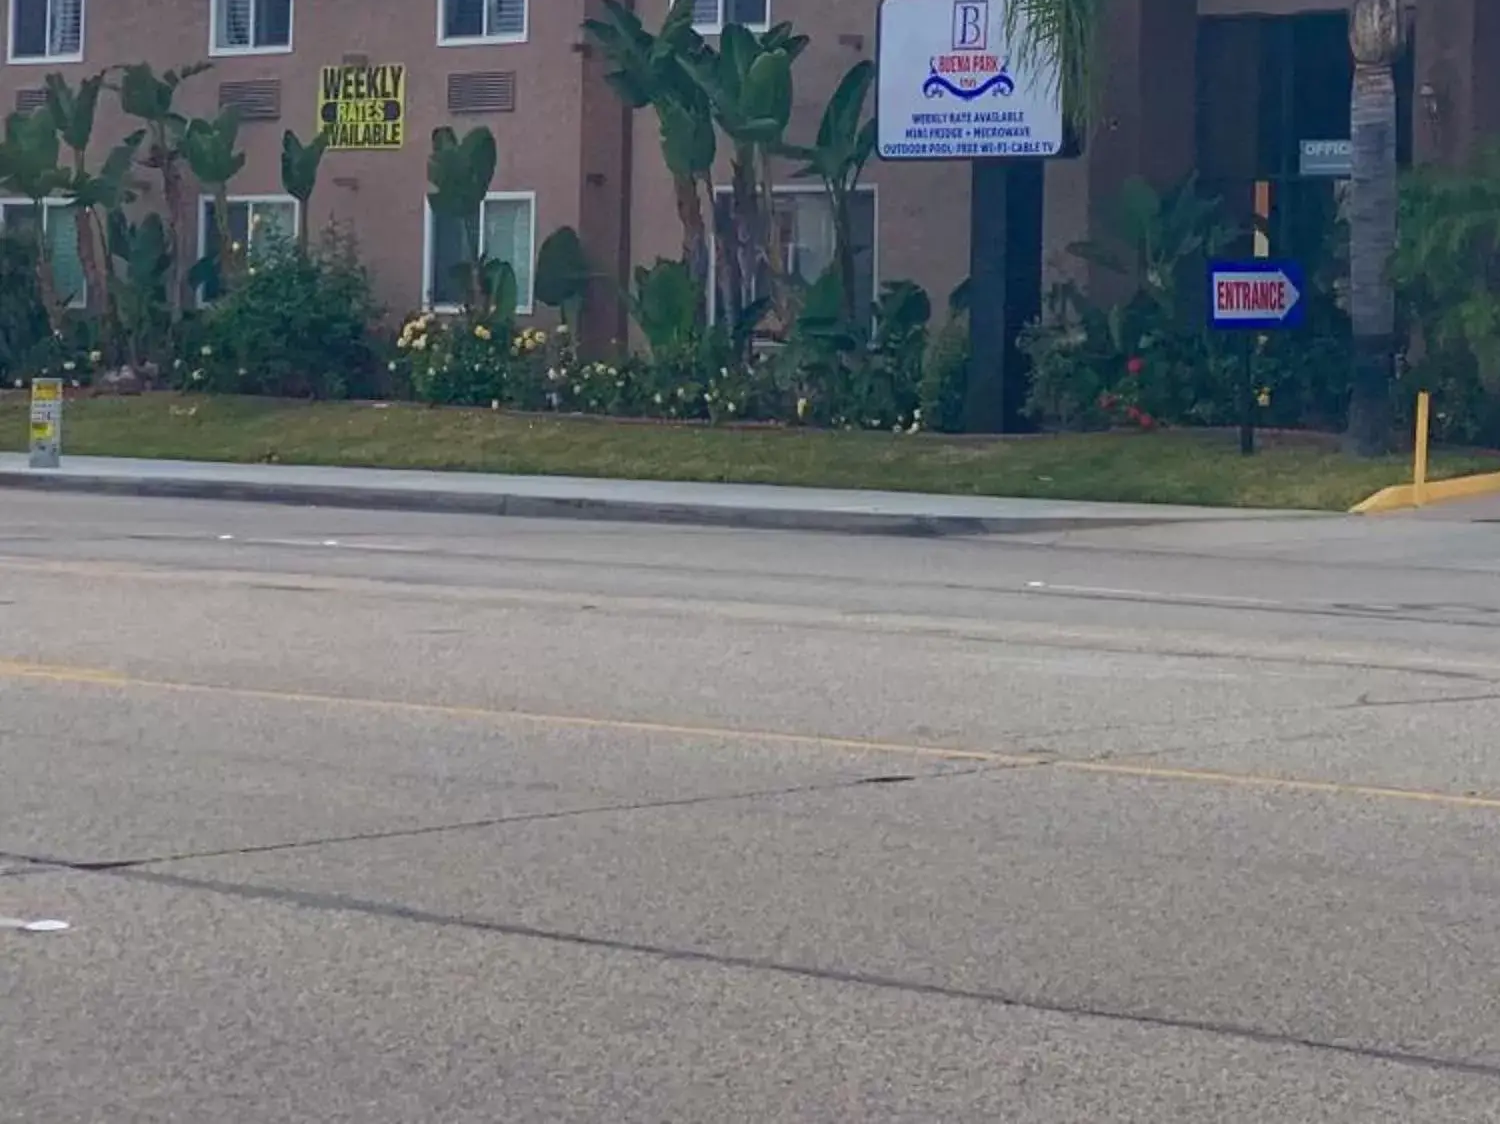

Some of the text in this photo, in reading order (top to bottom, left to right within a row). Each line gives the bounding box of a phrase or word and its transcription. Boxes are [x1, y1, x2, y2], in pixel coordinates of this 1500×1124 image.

[960, 6, 980, 45] B
[939, 55, 998, 73] BUENA PARK
[323, 65, 402, 100] WEEKLY
[338, 100, 384, 122] RATES
[912, 110, 1024, 125] WEEKLY RATE AVAILABLE
[973, 126, 1031, 138] MICROWAVE
[884, 143, 927, 154] OUTDOOR
[1042, 141, 1055, 152] TV
[1305, 142, 1352, 156] OFFIC
[1217, 281, 1286, 310] ENTRANCE
